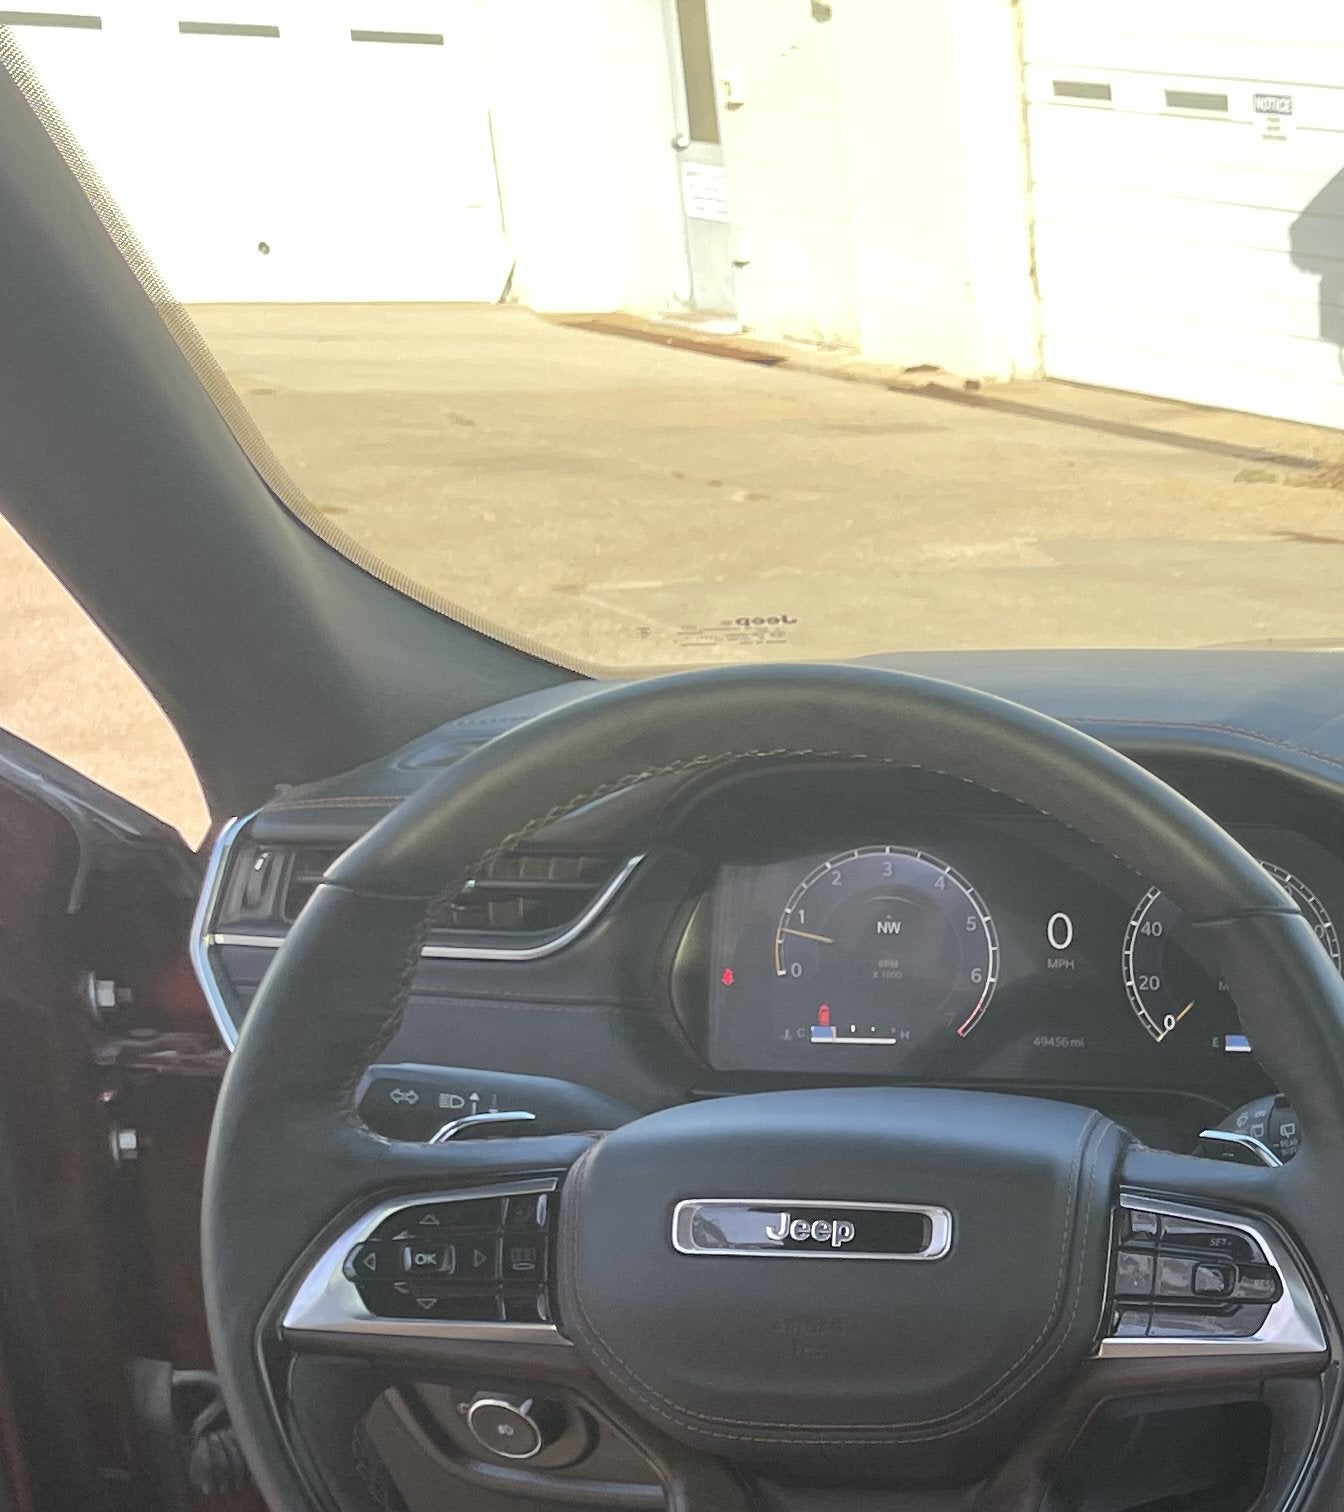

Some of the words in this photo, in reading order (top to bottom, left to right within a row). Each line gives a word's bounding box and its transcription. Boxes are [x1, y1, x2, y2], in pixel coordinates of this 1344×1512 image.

[882, 861, 893, 877] 3
[831, 871, 842, 886] 2
[934, 875, 945, 890] 4
[798, 909, 805, 924] 1
[966, 916, 977, 932] 5
[877, 921, 901, 934] NW
[1046, 912, 1073, 950] 0
[1141, 921, 1162, 937] 40
[790, 963, 802, 977] 0
[1047, 958, 1075, 970] MPH
[971, 967, 982, 983] 6
[1139, 975, 1160, 990] 20
[1164, 1014, 1176, 1030] 0
[1212, 1037, 1219, 1048] E
[765, 1212, 855, 1247] Jeep
[414, 1252, 437, 1265] OK
